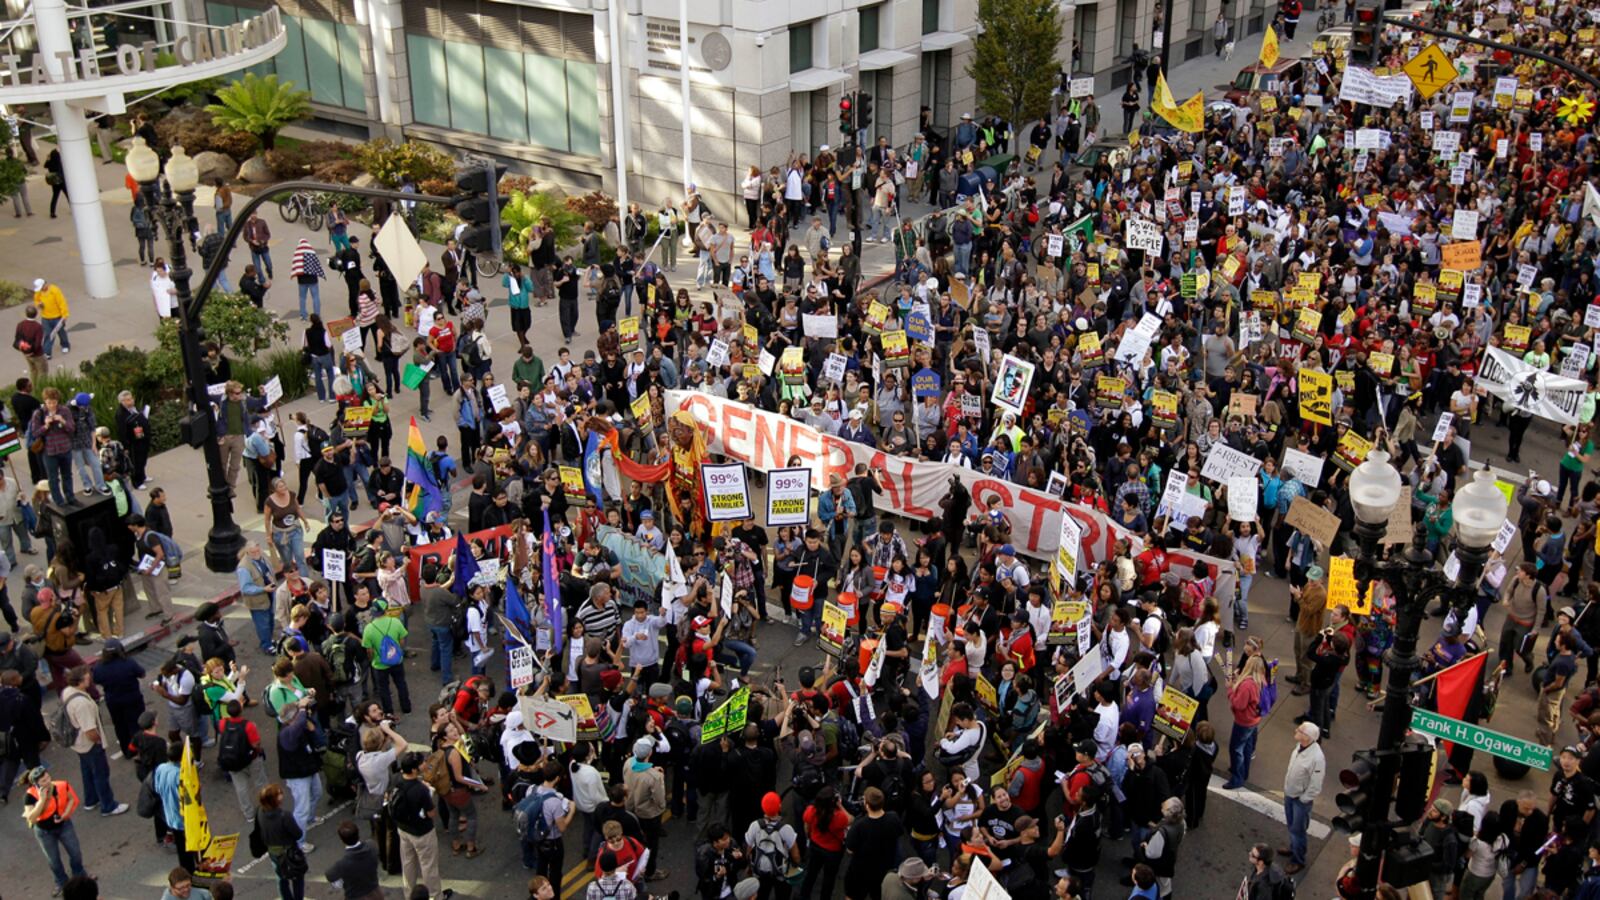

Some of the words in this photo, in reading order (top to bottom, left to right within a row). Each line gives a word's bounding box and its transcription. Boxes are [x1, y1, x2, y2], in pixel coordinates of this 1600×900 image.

[0, 48, 100, 87] TATE
[116, 40, 158, 76] OF
[1130, 234, 1161, 251] PEOPLE
[1214, 447, 1259, 472] ARREST
[710, 474, 739, 485] 99%
[775, 478, 804, 490] 99%
[1167, 482, 1182, 494] 99%
[679, 394, 935, 519] GENERAL
[971, 478, 1218, 596] STRIE
[710, 492, 744, 503] STRONG
[711, 501, 745, 509] FAMILIES
[771, 498, 805, 508] STRONG
[771, 506, 805, 515] FAMILIES
[327, 563, 343, 571] 99%
[511, 647, 529, 660] GIVE
[511, 659, 520, 669] US
[1411, 711, 1451, 735] Frank
[1455, 725, 1469, 741] H.
[1473, 731, 1522, 757] Ogawa
[1523, 743, 1551, 757] PLAZA
